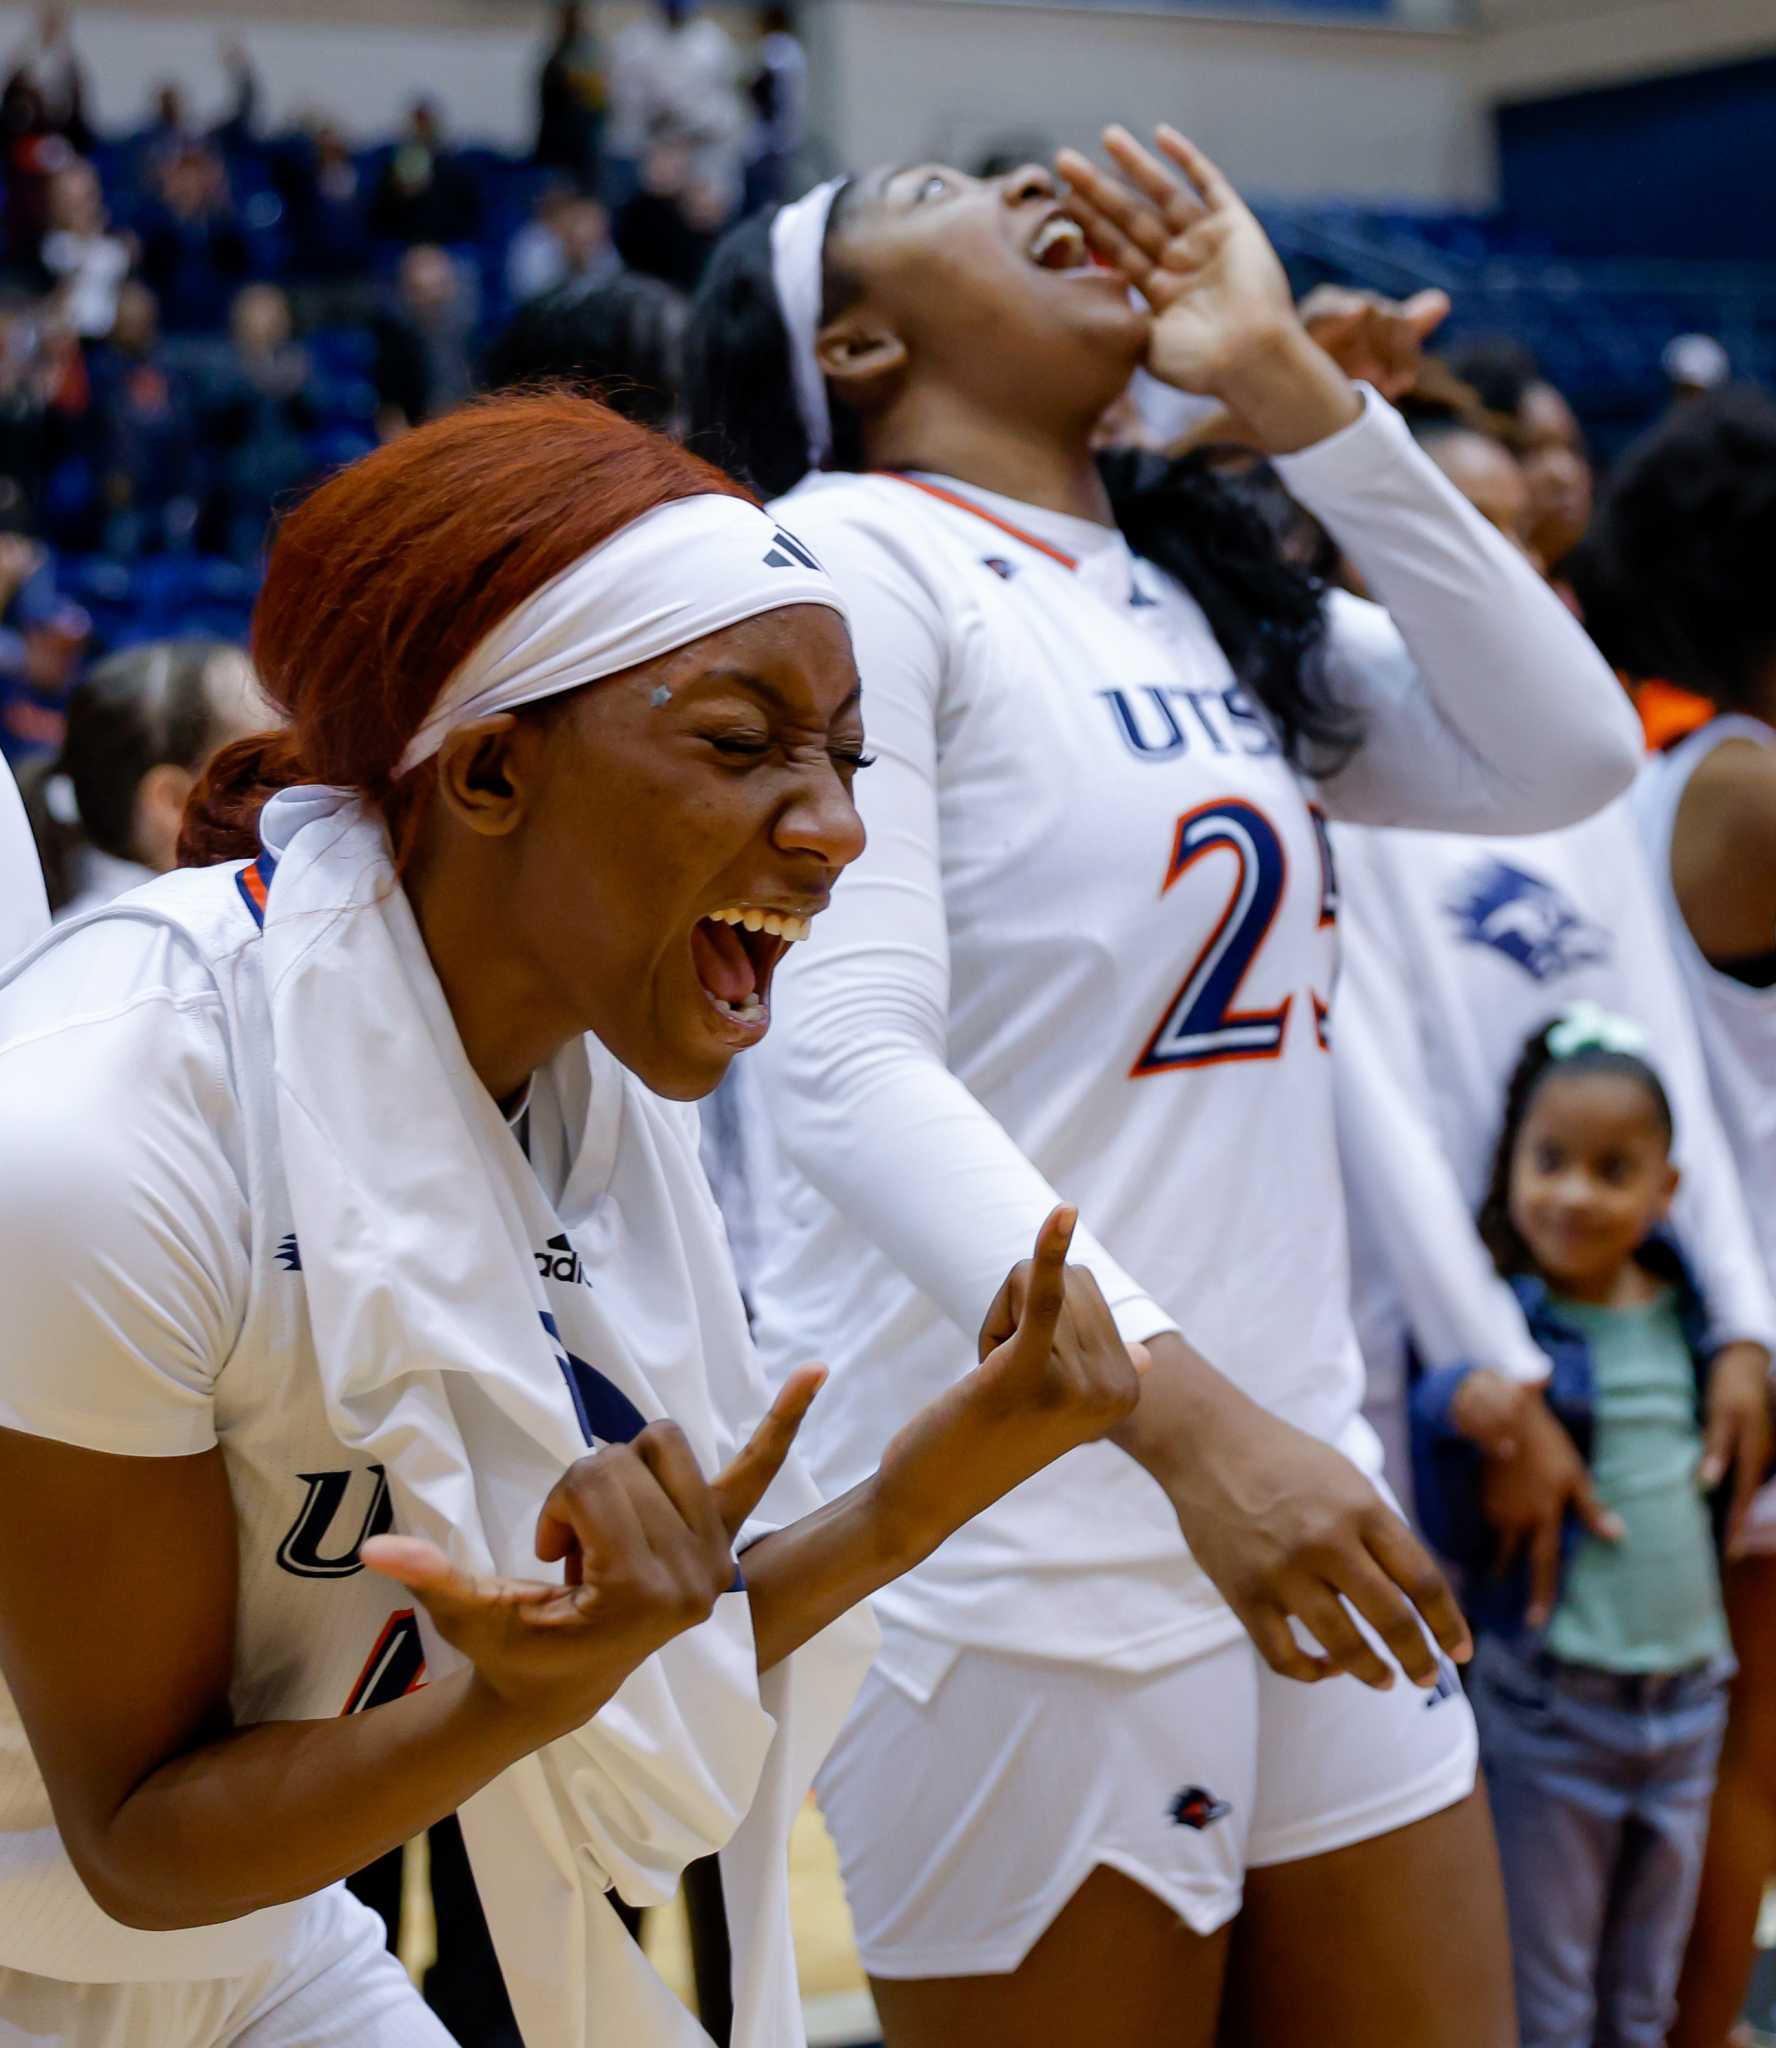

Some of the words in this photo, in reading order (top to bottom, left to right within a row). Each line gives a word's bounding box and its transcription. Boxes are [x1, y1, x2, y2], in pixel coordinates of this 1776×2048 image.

[1096, 686, 1282, 762] UTS
[1129, 796, 1341, 1079] 2
[534, 1250, 593, 1288] adi
